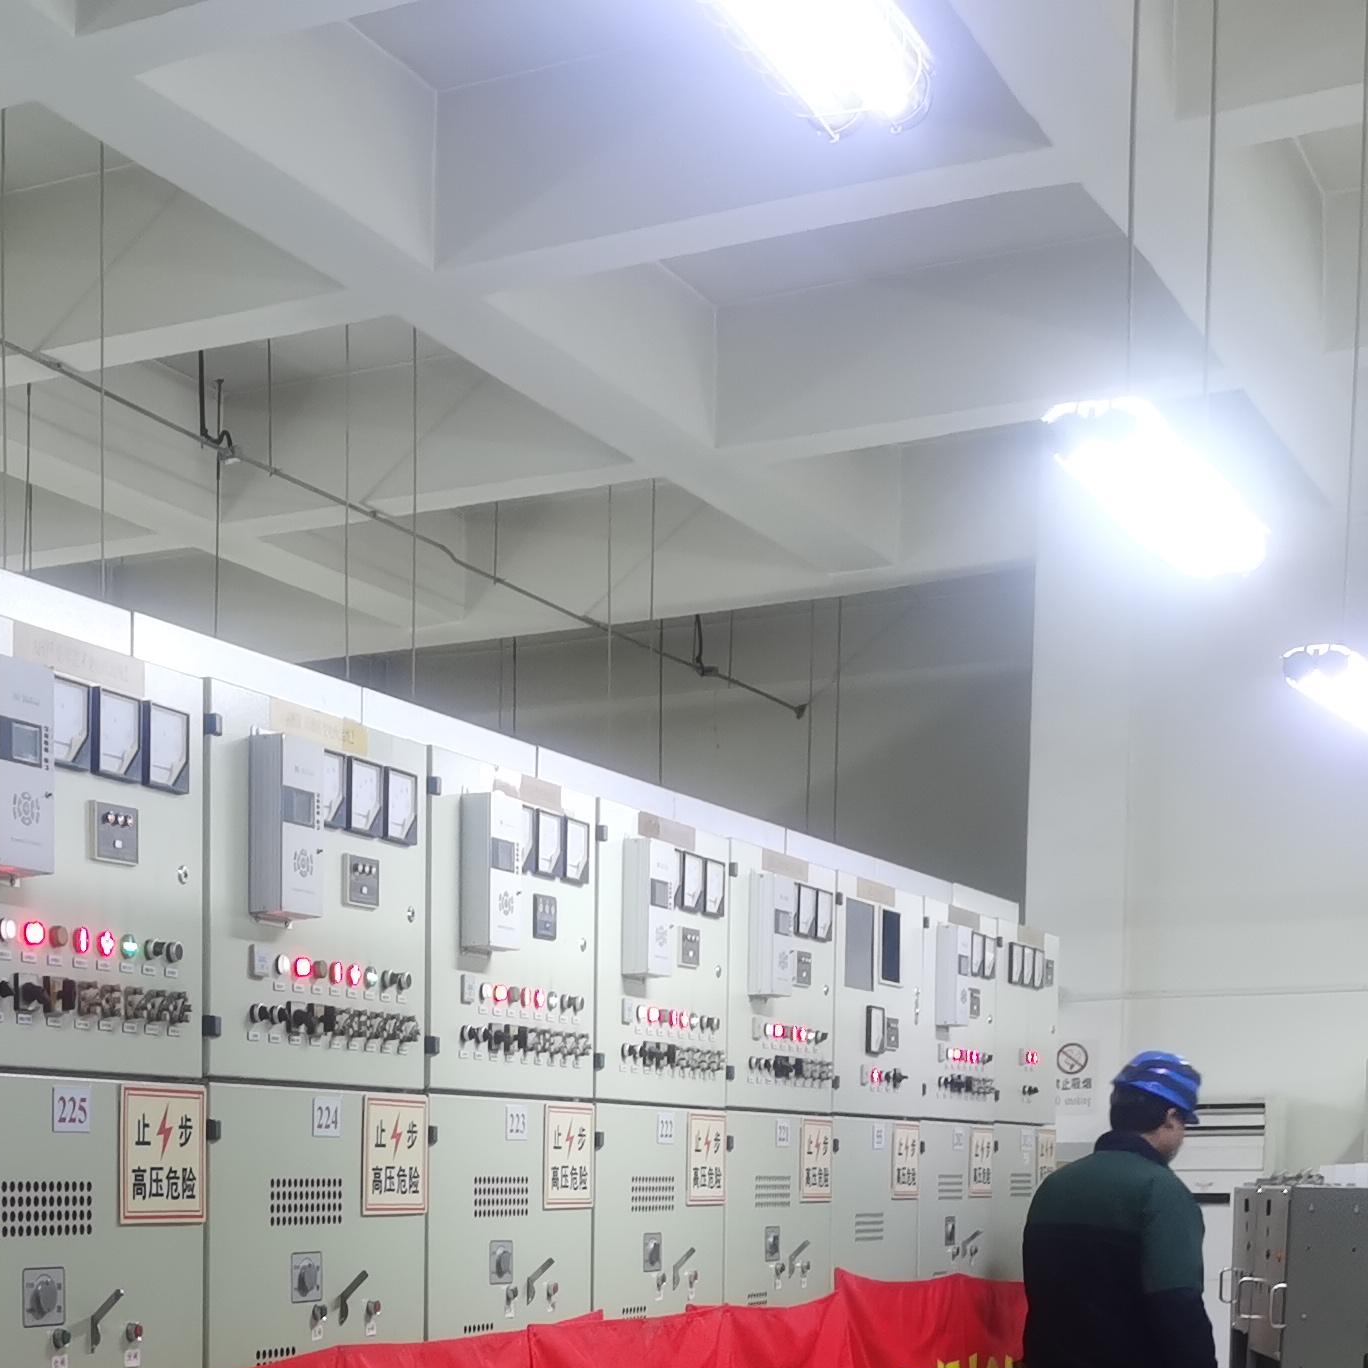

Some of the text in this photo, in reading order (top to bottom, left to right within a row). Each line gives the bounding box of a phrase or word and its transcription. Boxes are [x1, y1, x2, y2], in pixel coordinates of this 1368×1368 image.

[56, 1095, 88, 1126] 225
[316, 1104, 339, 1131] 224
[131, 1166, 198, 1202] 高压危险
[371, 1165, 421, 1197] 高压危险
